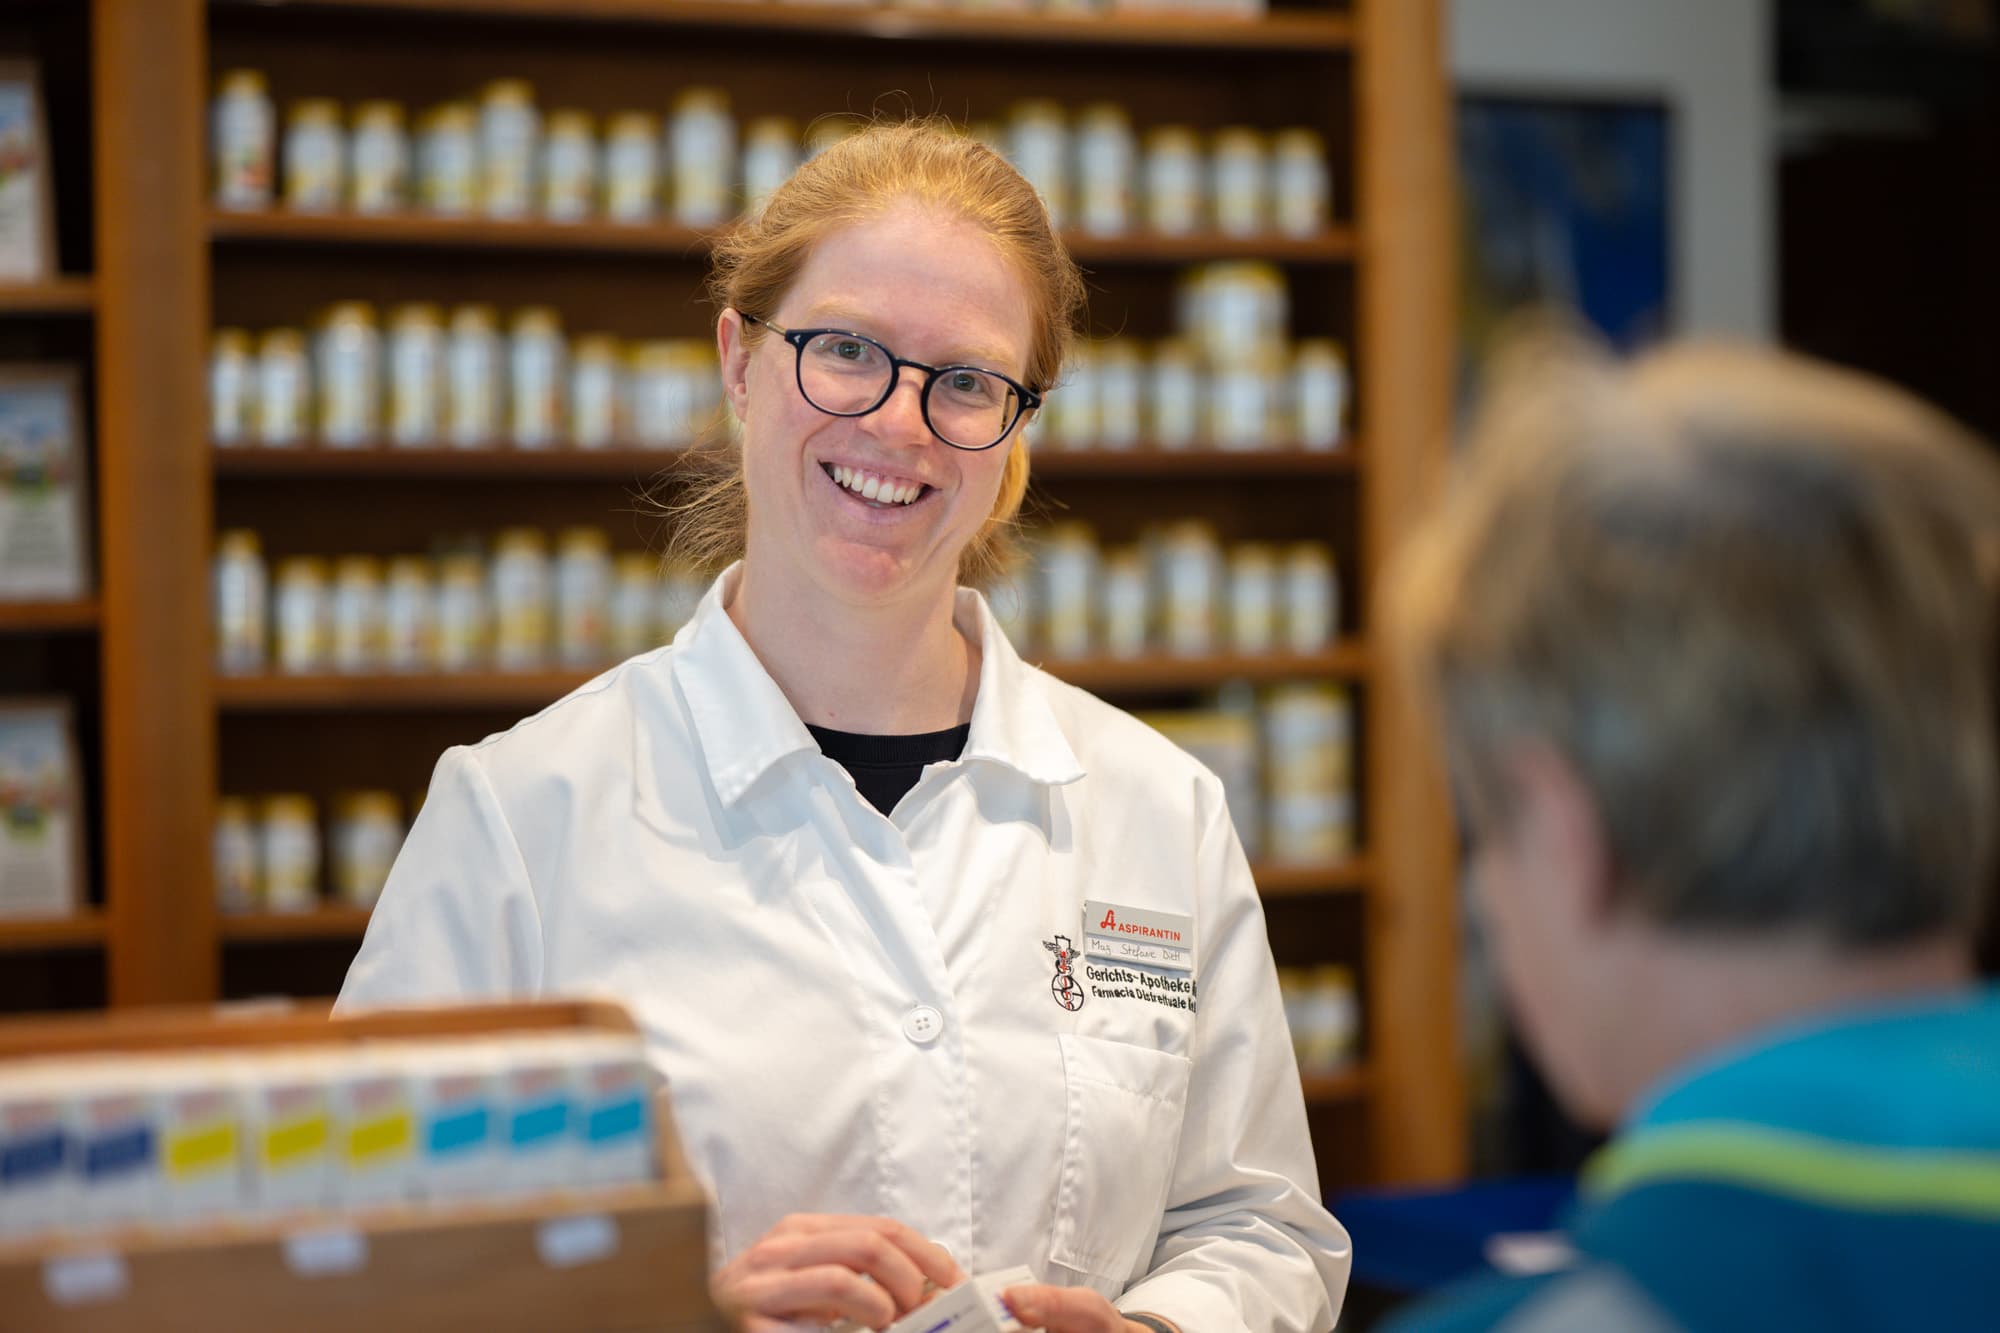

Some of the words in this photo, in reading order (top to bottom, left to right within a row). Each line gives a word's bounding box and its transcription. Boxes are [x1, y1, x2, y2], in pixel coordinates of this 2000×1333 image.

[1118, 922, 1181, 941] ASPIRANTIN
[1091, 985, 1136, 999] Farmacia
[1140, 972, 1191, 994] Apotheke
